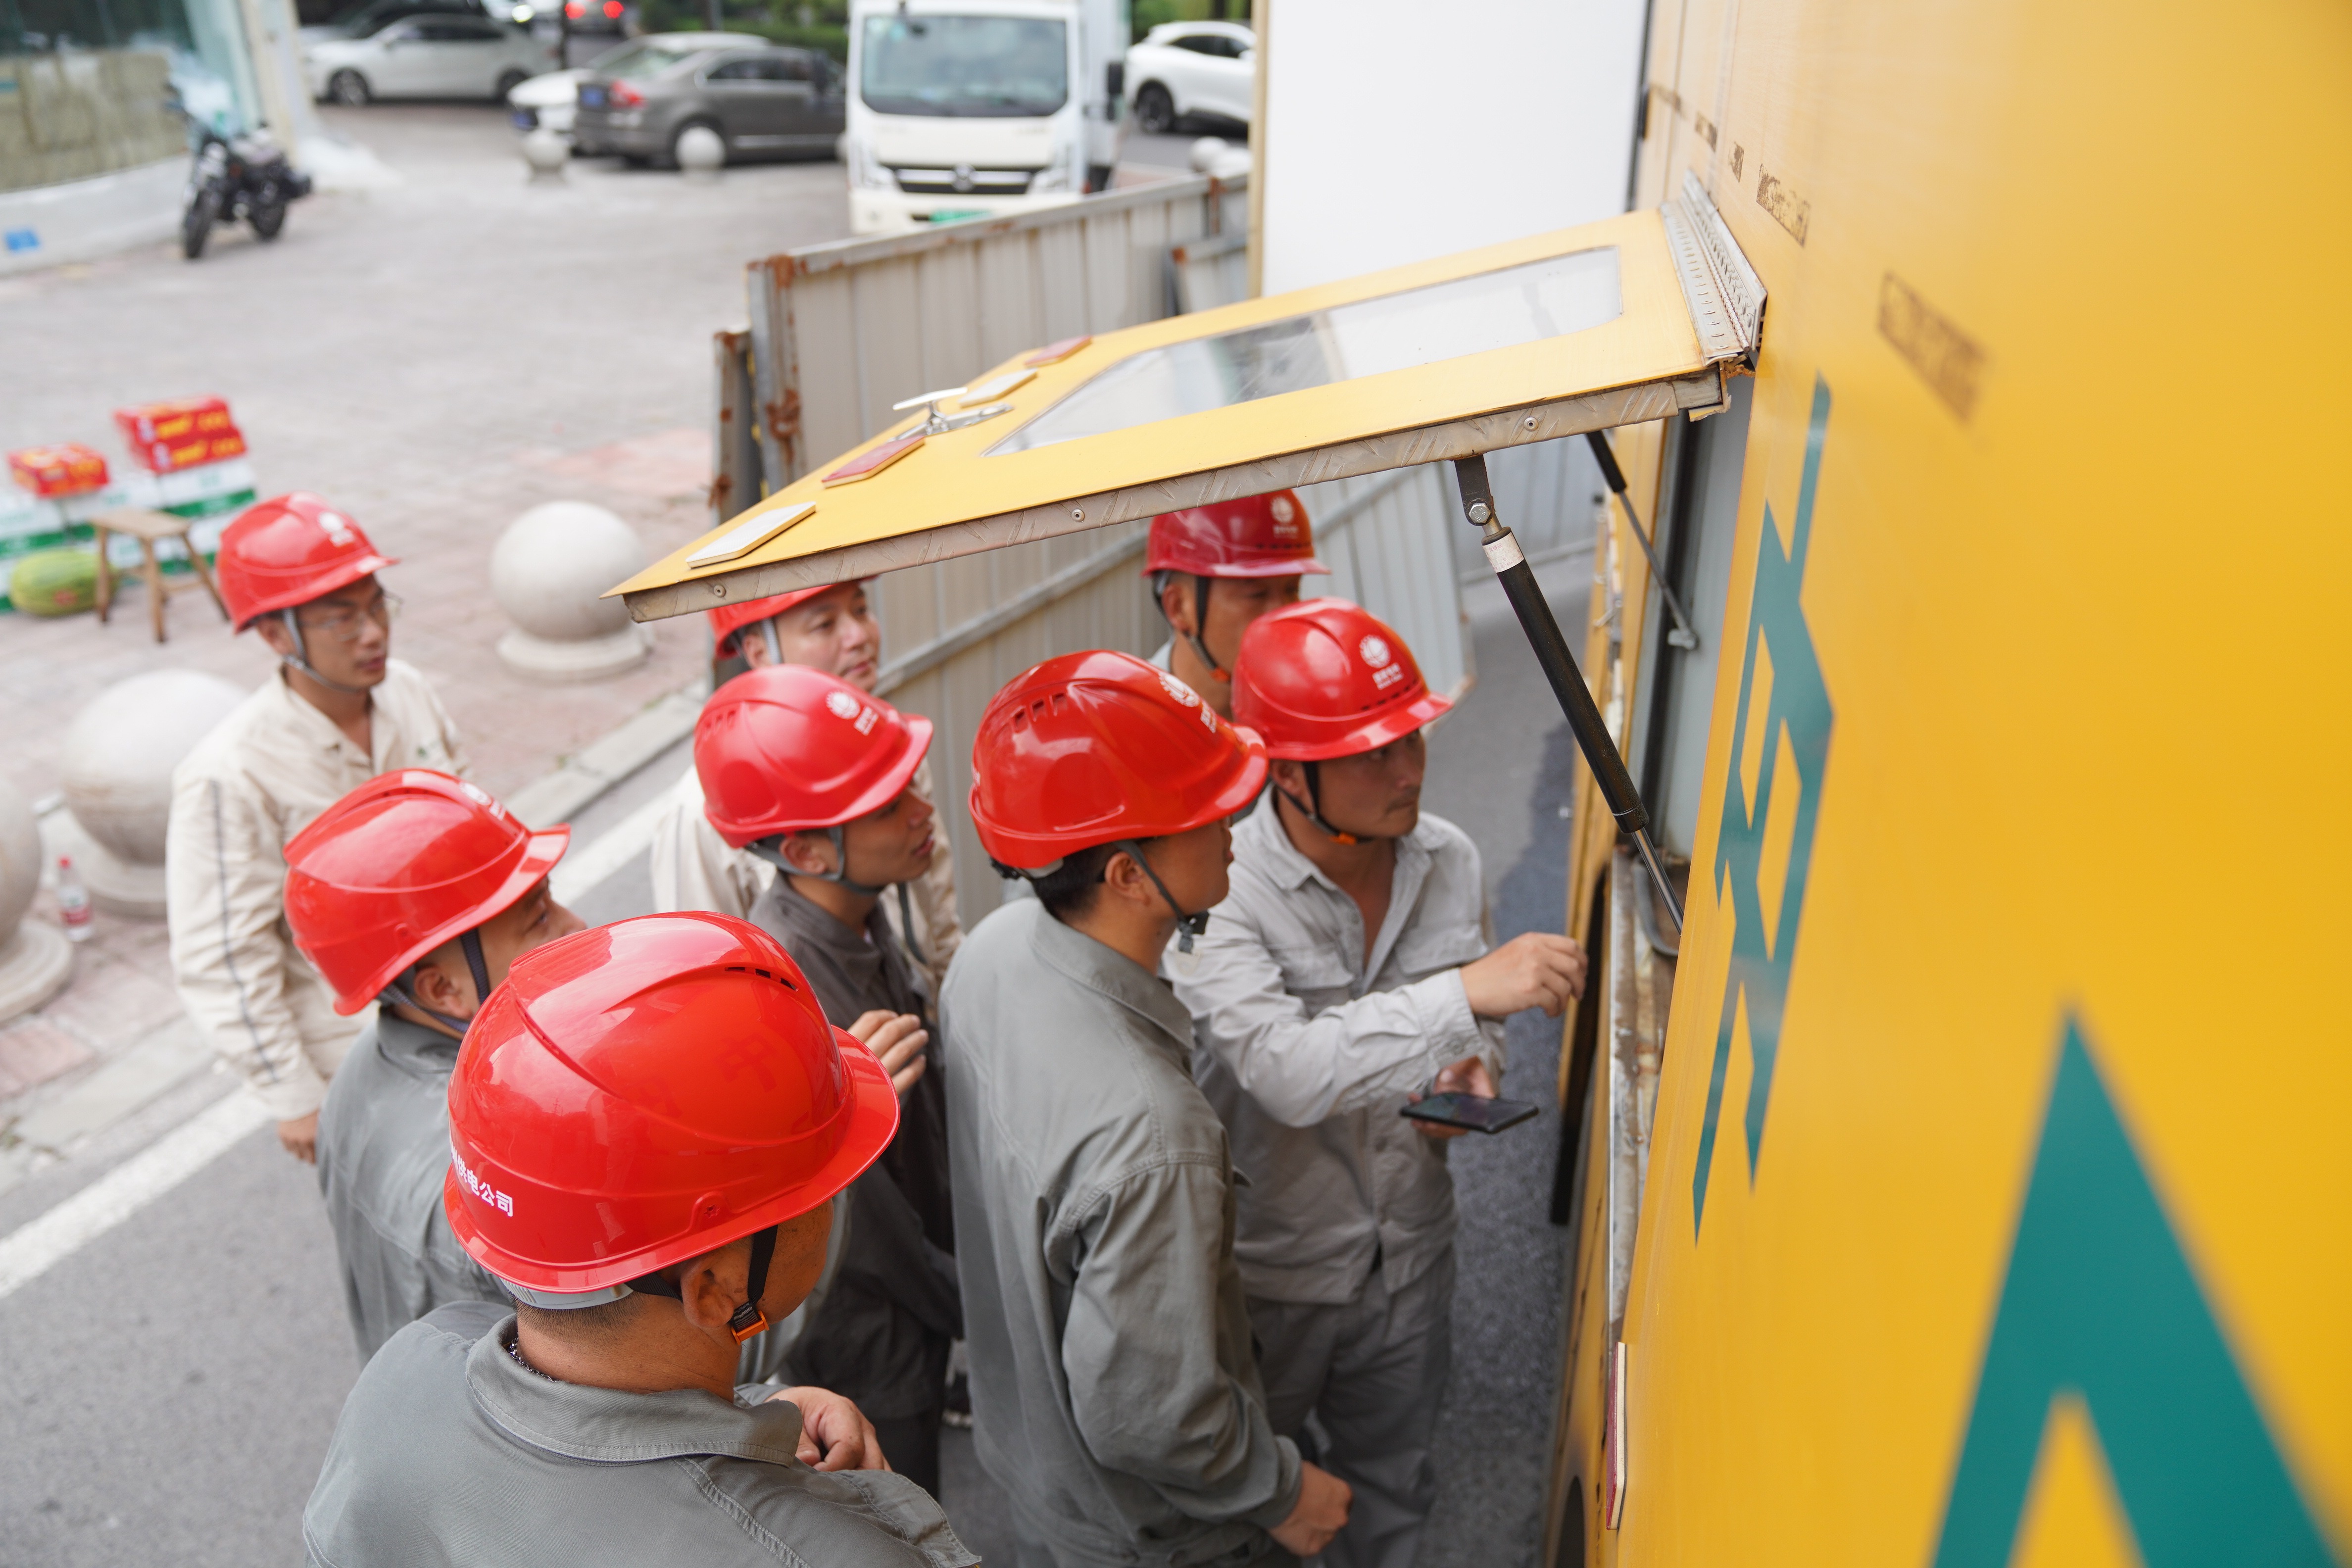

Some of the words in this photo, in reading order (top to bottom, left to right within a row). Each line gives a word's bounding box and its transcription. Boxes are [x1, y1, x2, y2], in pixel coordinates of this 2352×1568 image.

[1488, 542, 1503, 552] 合格证
[449, 1137, 513, 1217] 州供电公司
